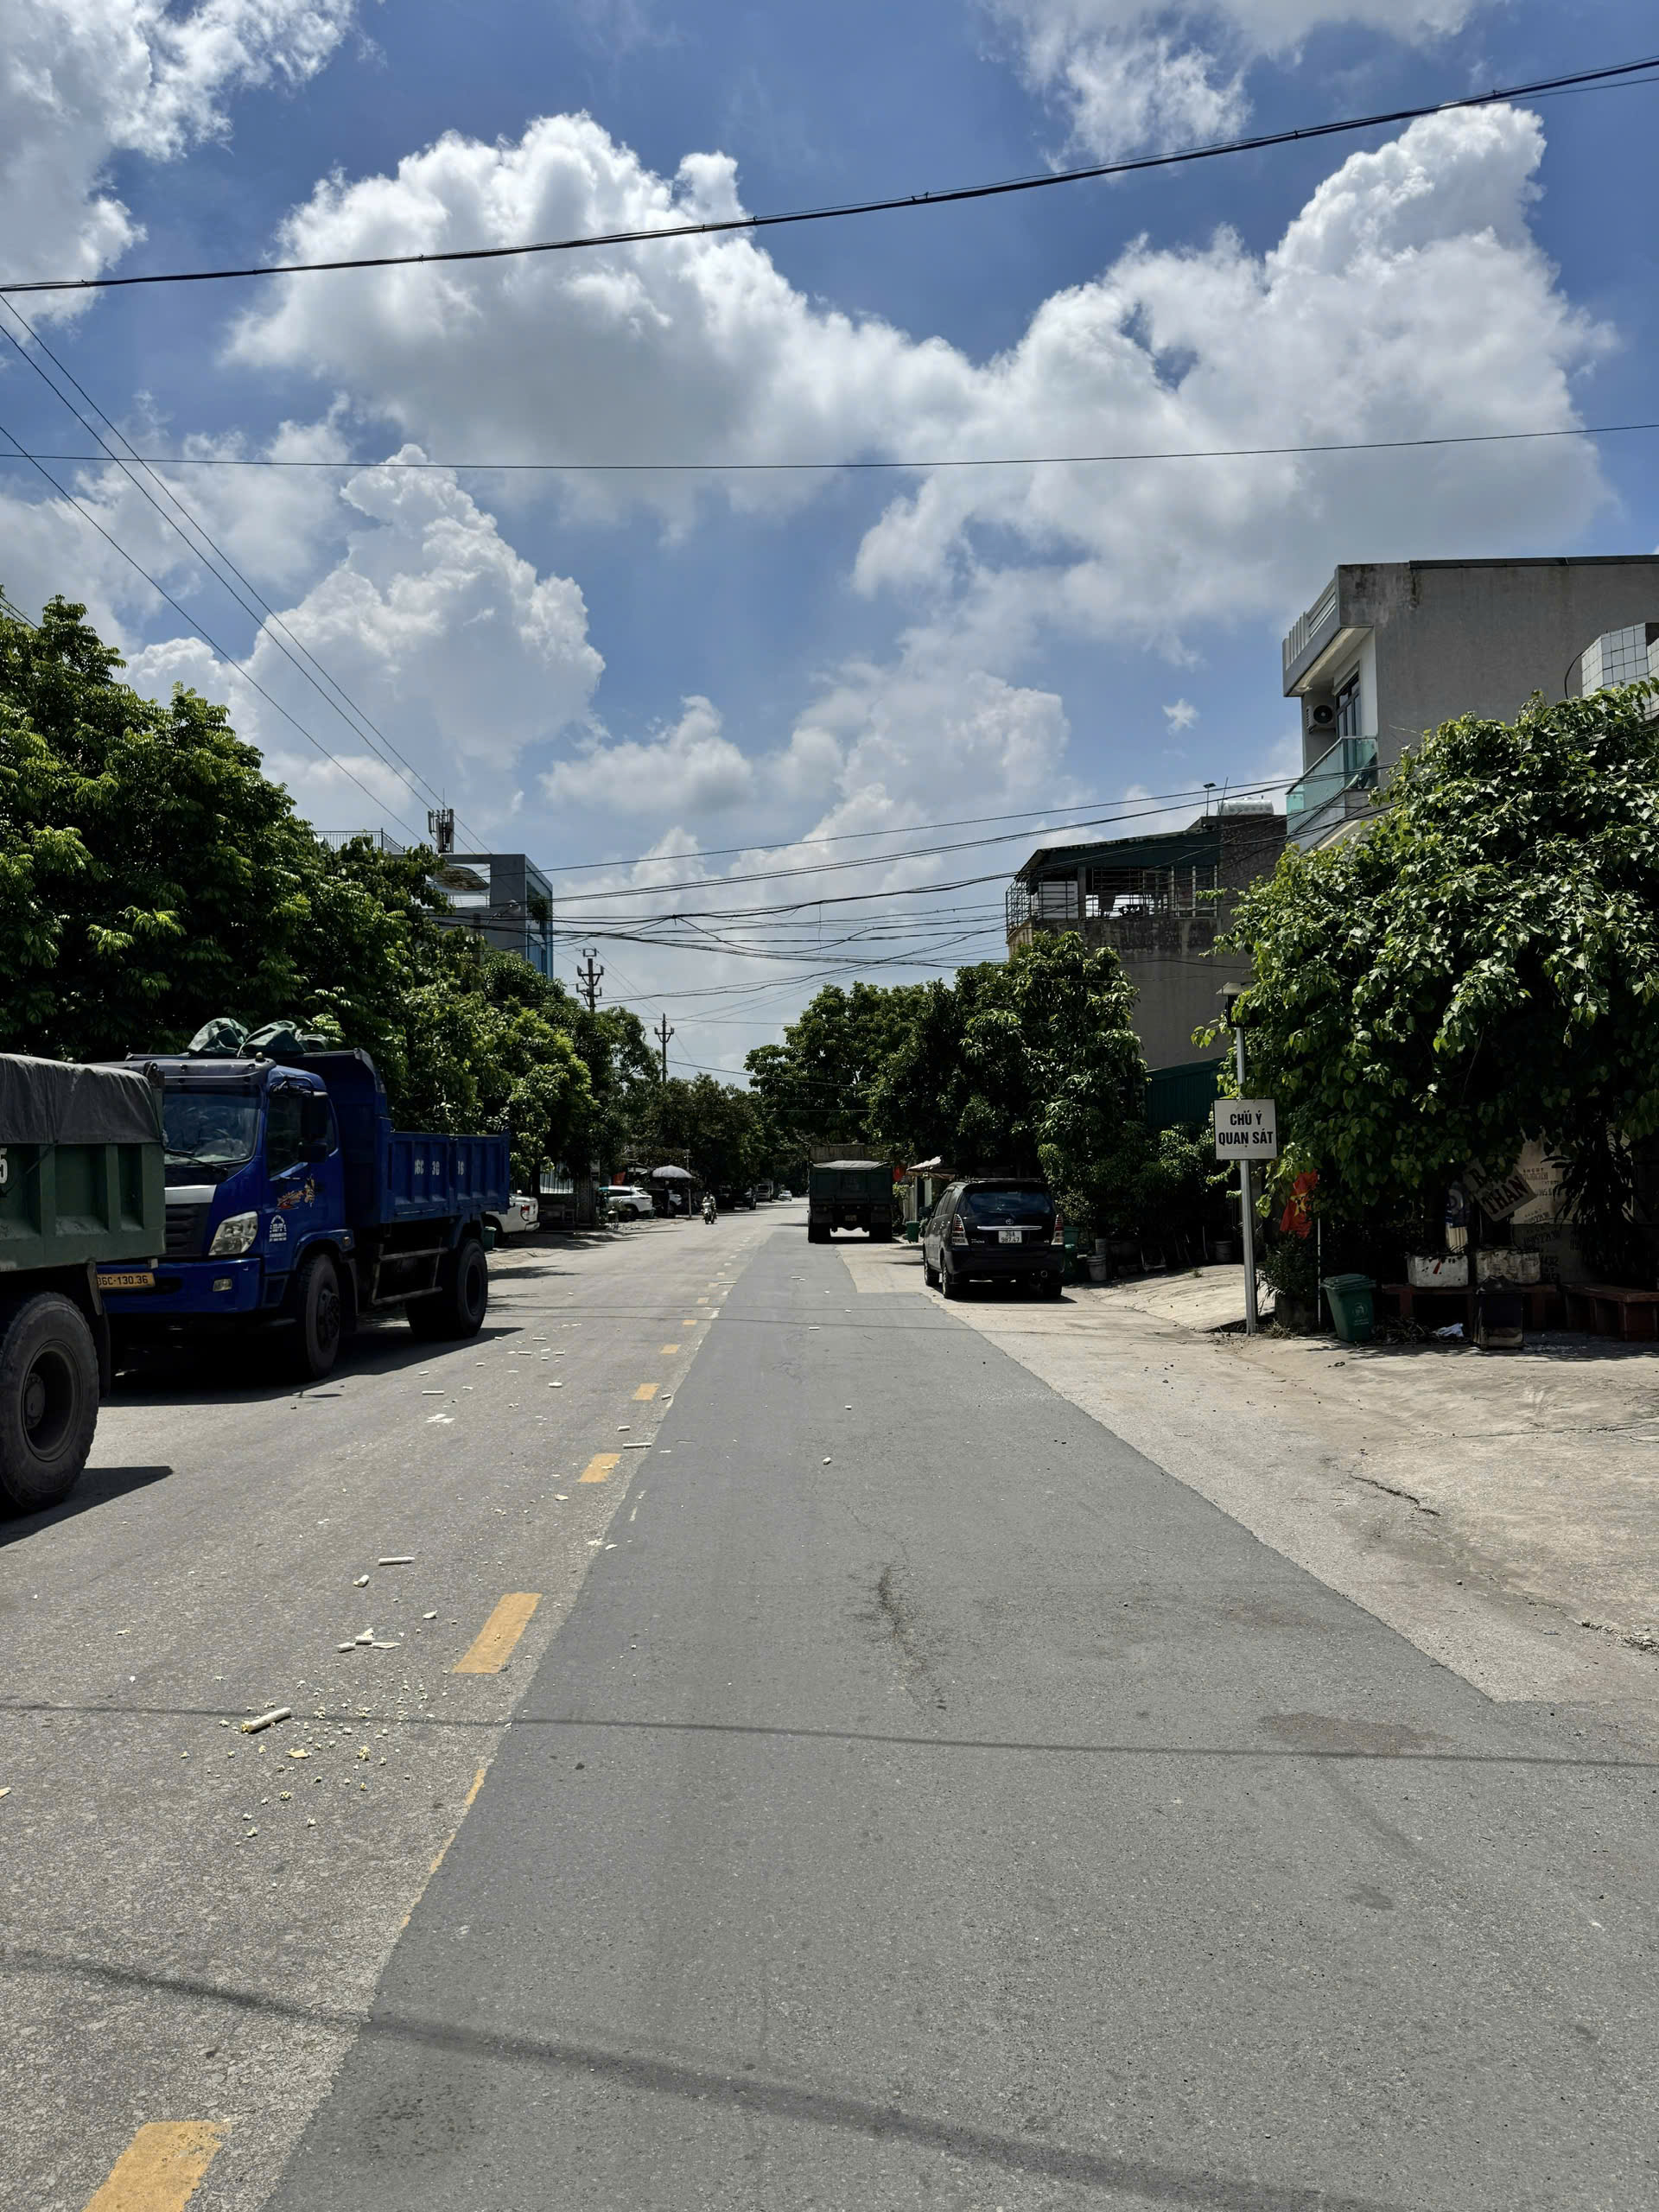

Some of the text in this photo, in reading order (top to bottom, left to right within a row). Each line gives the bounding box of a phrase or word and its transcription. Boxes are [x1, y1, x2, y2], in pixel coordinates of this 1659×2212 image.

[1230, 1110, 1262, 1125] CHÚ Ý
[1218, 1128, 1273, 1146] QUAN SÁT
[1481, 1176, 1528, 1214] THAN
